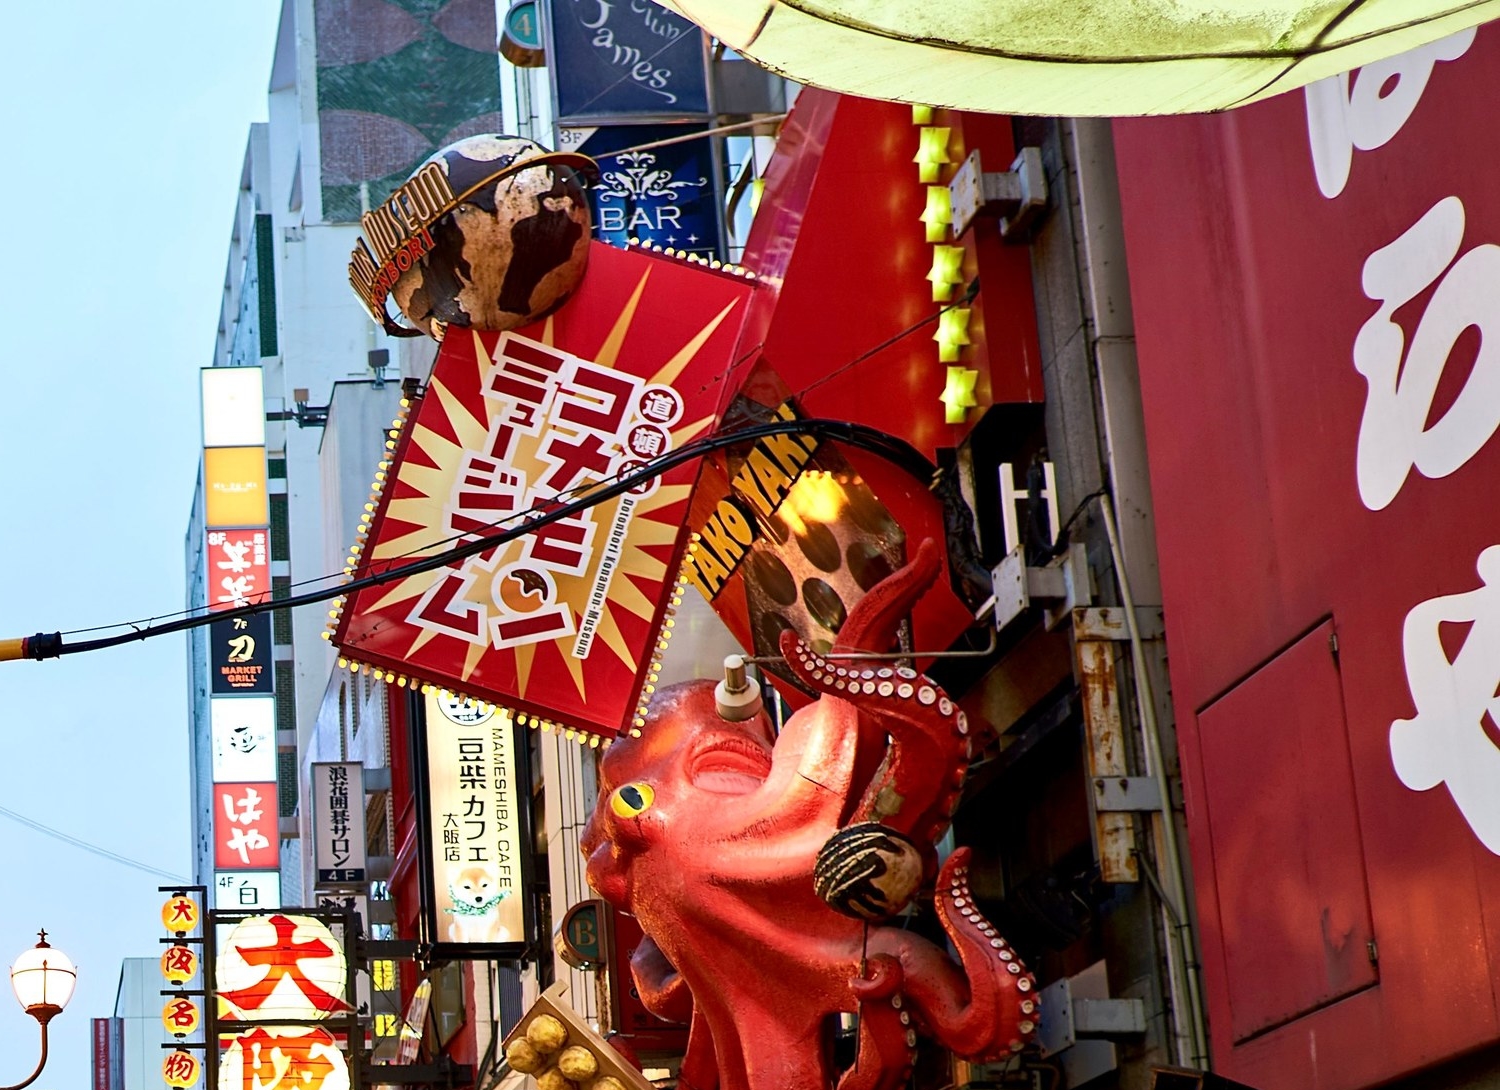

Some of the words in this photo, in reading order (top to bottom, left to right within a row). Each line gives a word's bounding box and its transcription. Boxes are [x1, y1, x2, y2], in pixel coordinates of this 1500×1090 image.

[560, 131, 583, 144] 3F
[362, 162, 454, 264] MUSEUM
[601, 206, 682, 231] BAR
[611, 498, 635, 559] Dotonbori
[683, 499, 755, 603] TAKO
[233, 618, 248, 630] 7F
[221, 666, 262, 675] MARKET
[458, 737, 489, 862] 豆柴カフェ
[492, 728, 509, 832] MAMESHIBA
[223, 788, 269, 864] はや
[329, 766, 351, 868] 浪花囲碁サロン
[443, 813, 460, 862] 大阪店
[219, 877, 234, 888] 4F
[497, 839, 512, 888] CAFE
[573, 919, 596, 947] B
